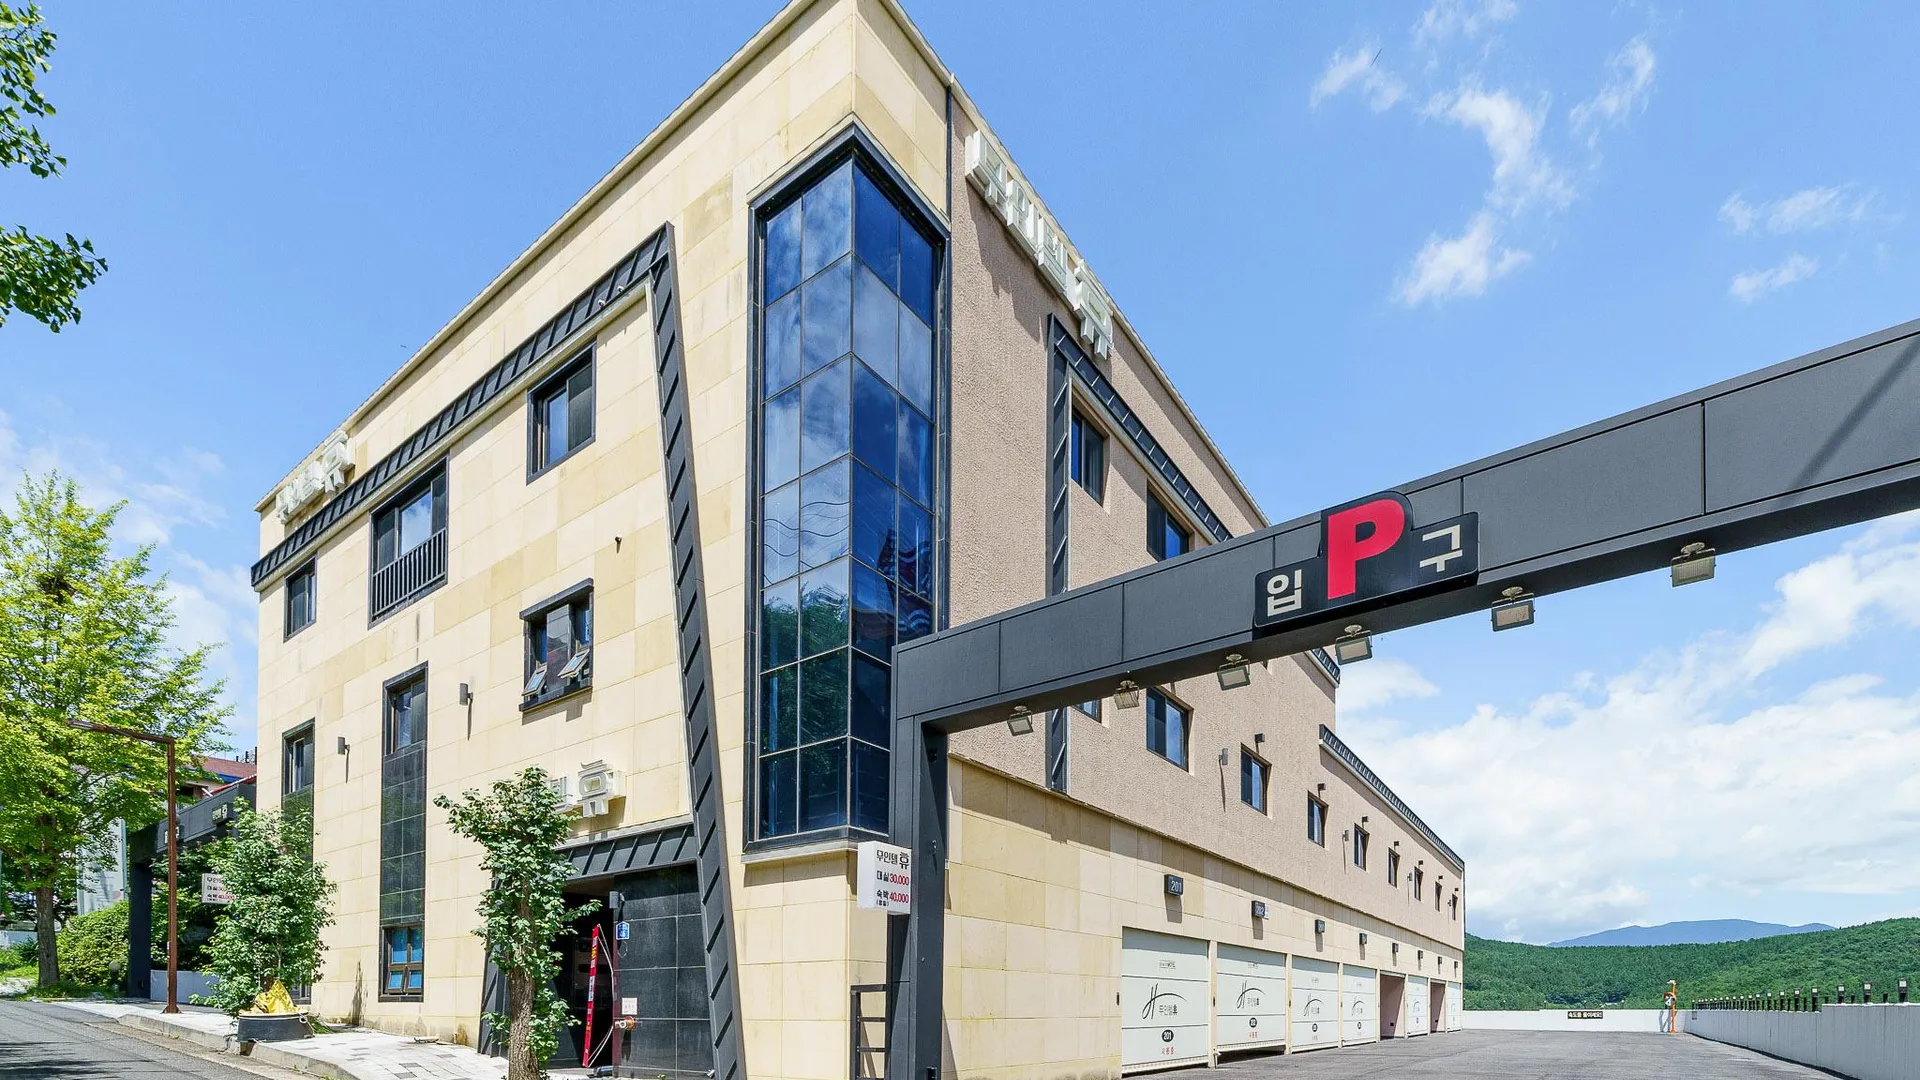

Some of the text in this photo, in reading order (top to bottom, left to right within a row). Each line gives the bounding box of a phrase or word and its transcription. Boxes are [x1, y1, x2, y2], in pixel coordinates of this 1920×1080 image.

[1267, 498, 1464, 617] 입 P 구
[889, 873, 910, 886] 30,000
[1171, 880, 1182, 892] 201
[889, 891, 910, 904] 40,000
[1163, 1031, 1172, 1040] 201
